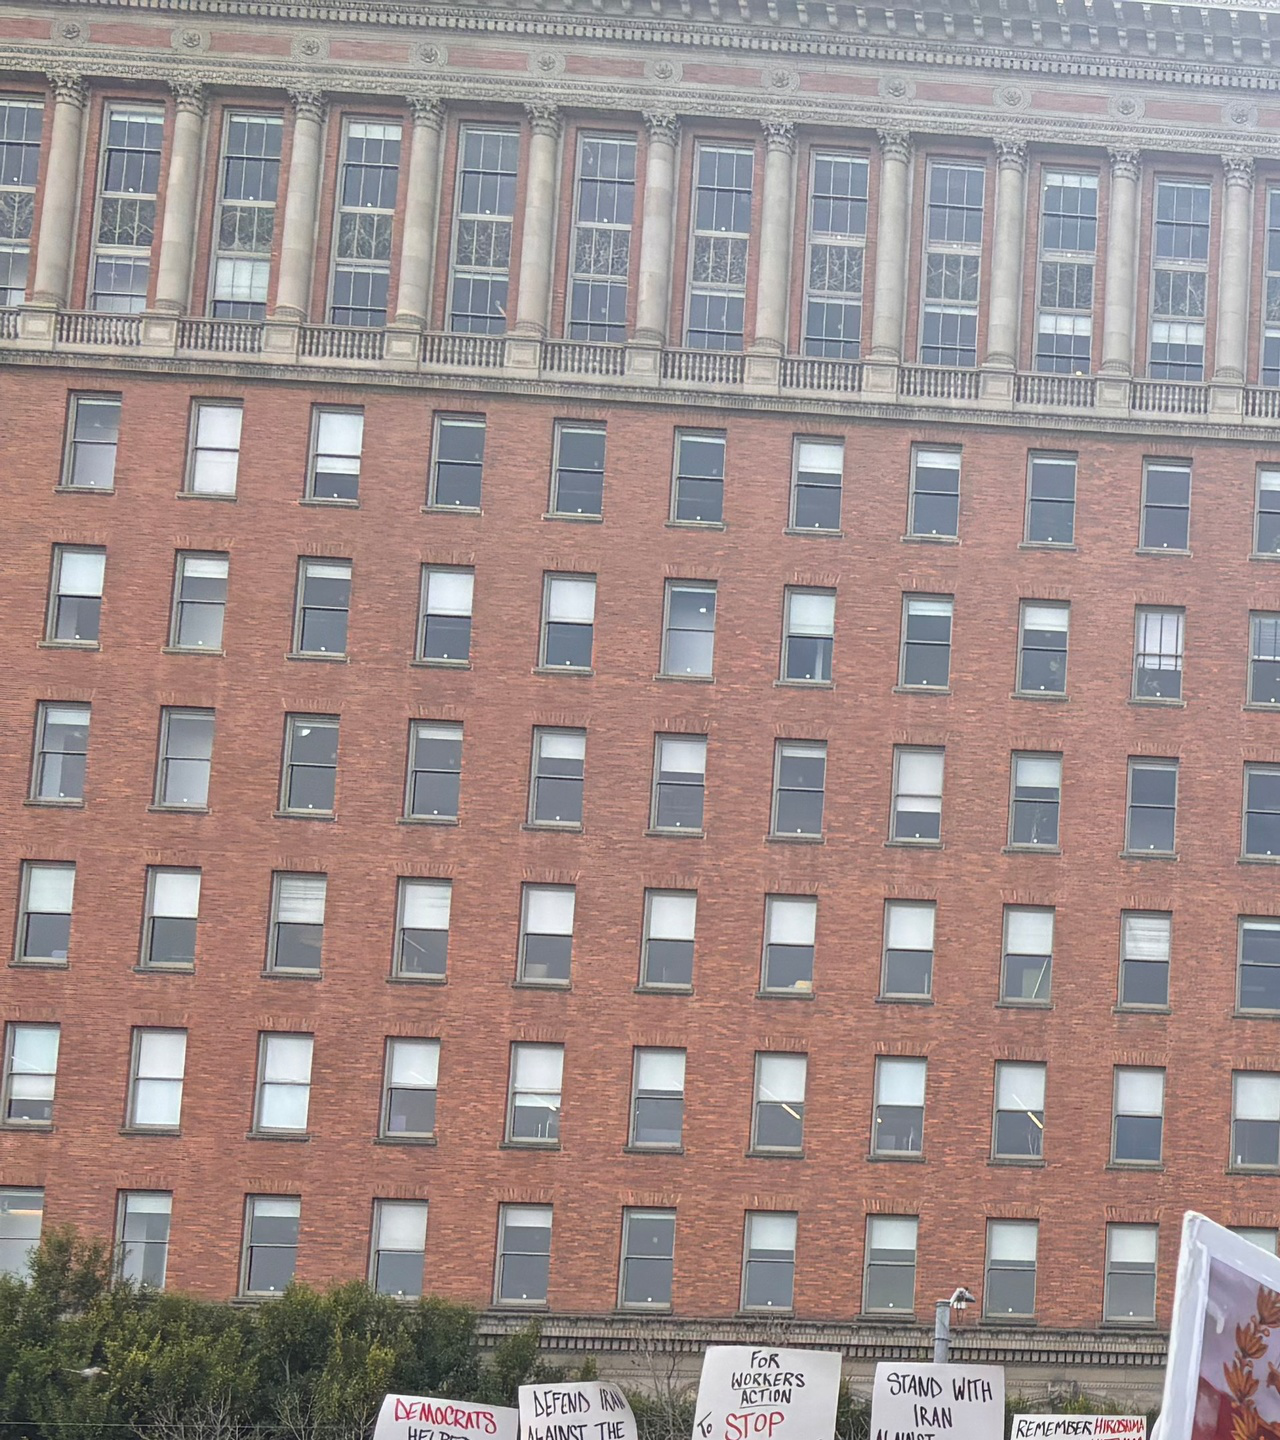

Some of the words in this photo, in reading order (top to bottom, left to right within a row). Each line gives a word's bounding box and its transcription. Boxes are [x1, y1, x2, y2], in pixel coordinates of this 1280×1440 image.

[732, 1372, 805, 1388] WORKERS
[887, 1373, 942, 1398] STAND
[953, 1377, 992, 1402] WITH
[534, 1389, 590, 1417] DEFEND
[600, 1388, 625, 1412] IRAN
[741, 1389, 792, 1405] ACTION
[395, 1398, 497, 1434] DEMOCRATS
[914, 1404, 953, 1428] IRAN
[594, 1421, 625, 1440] THE
[1016, 1420, 1092, 1439] REMEMBER
